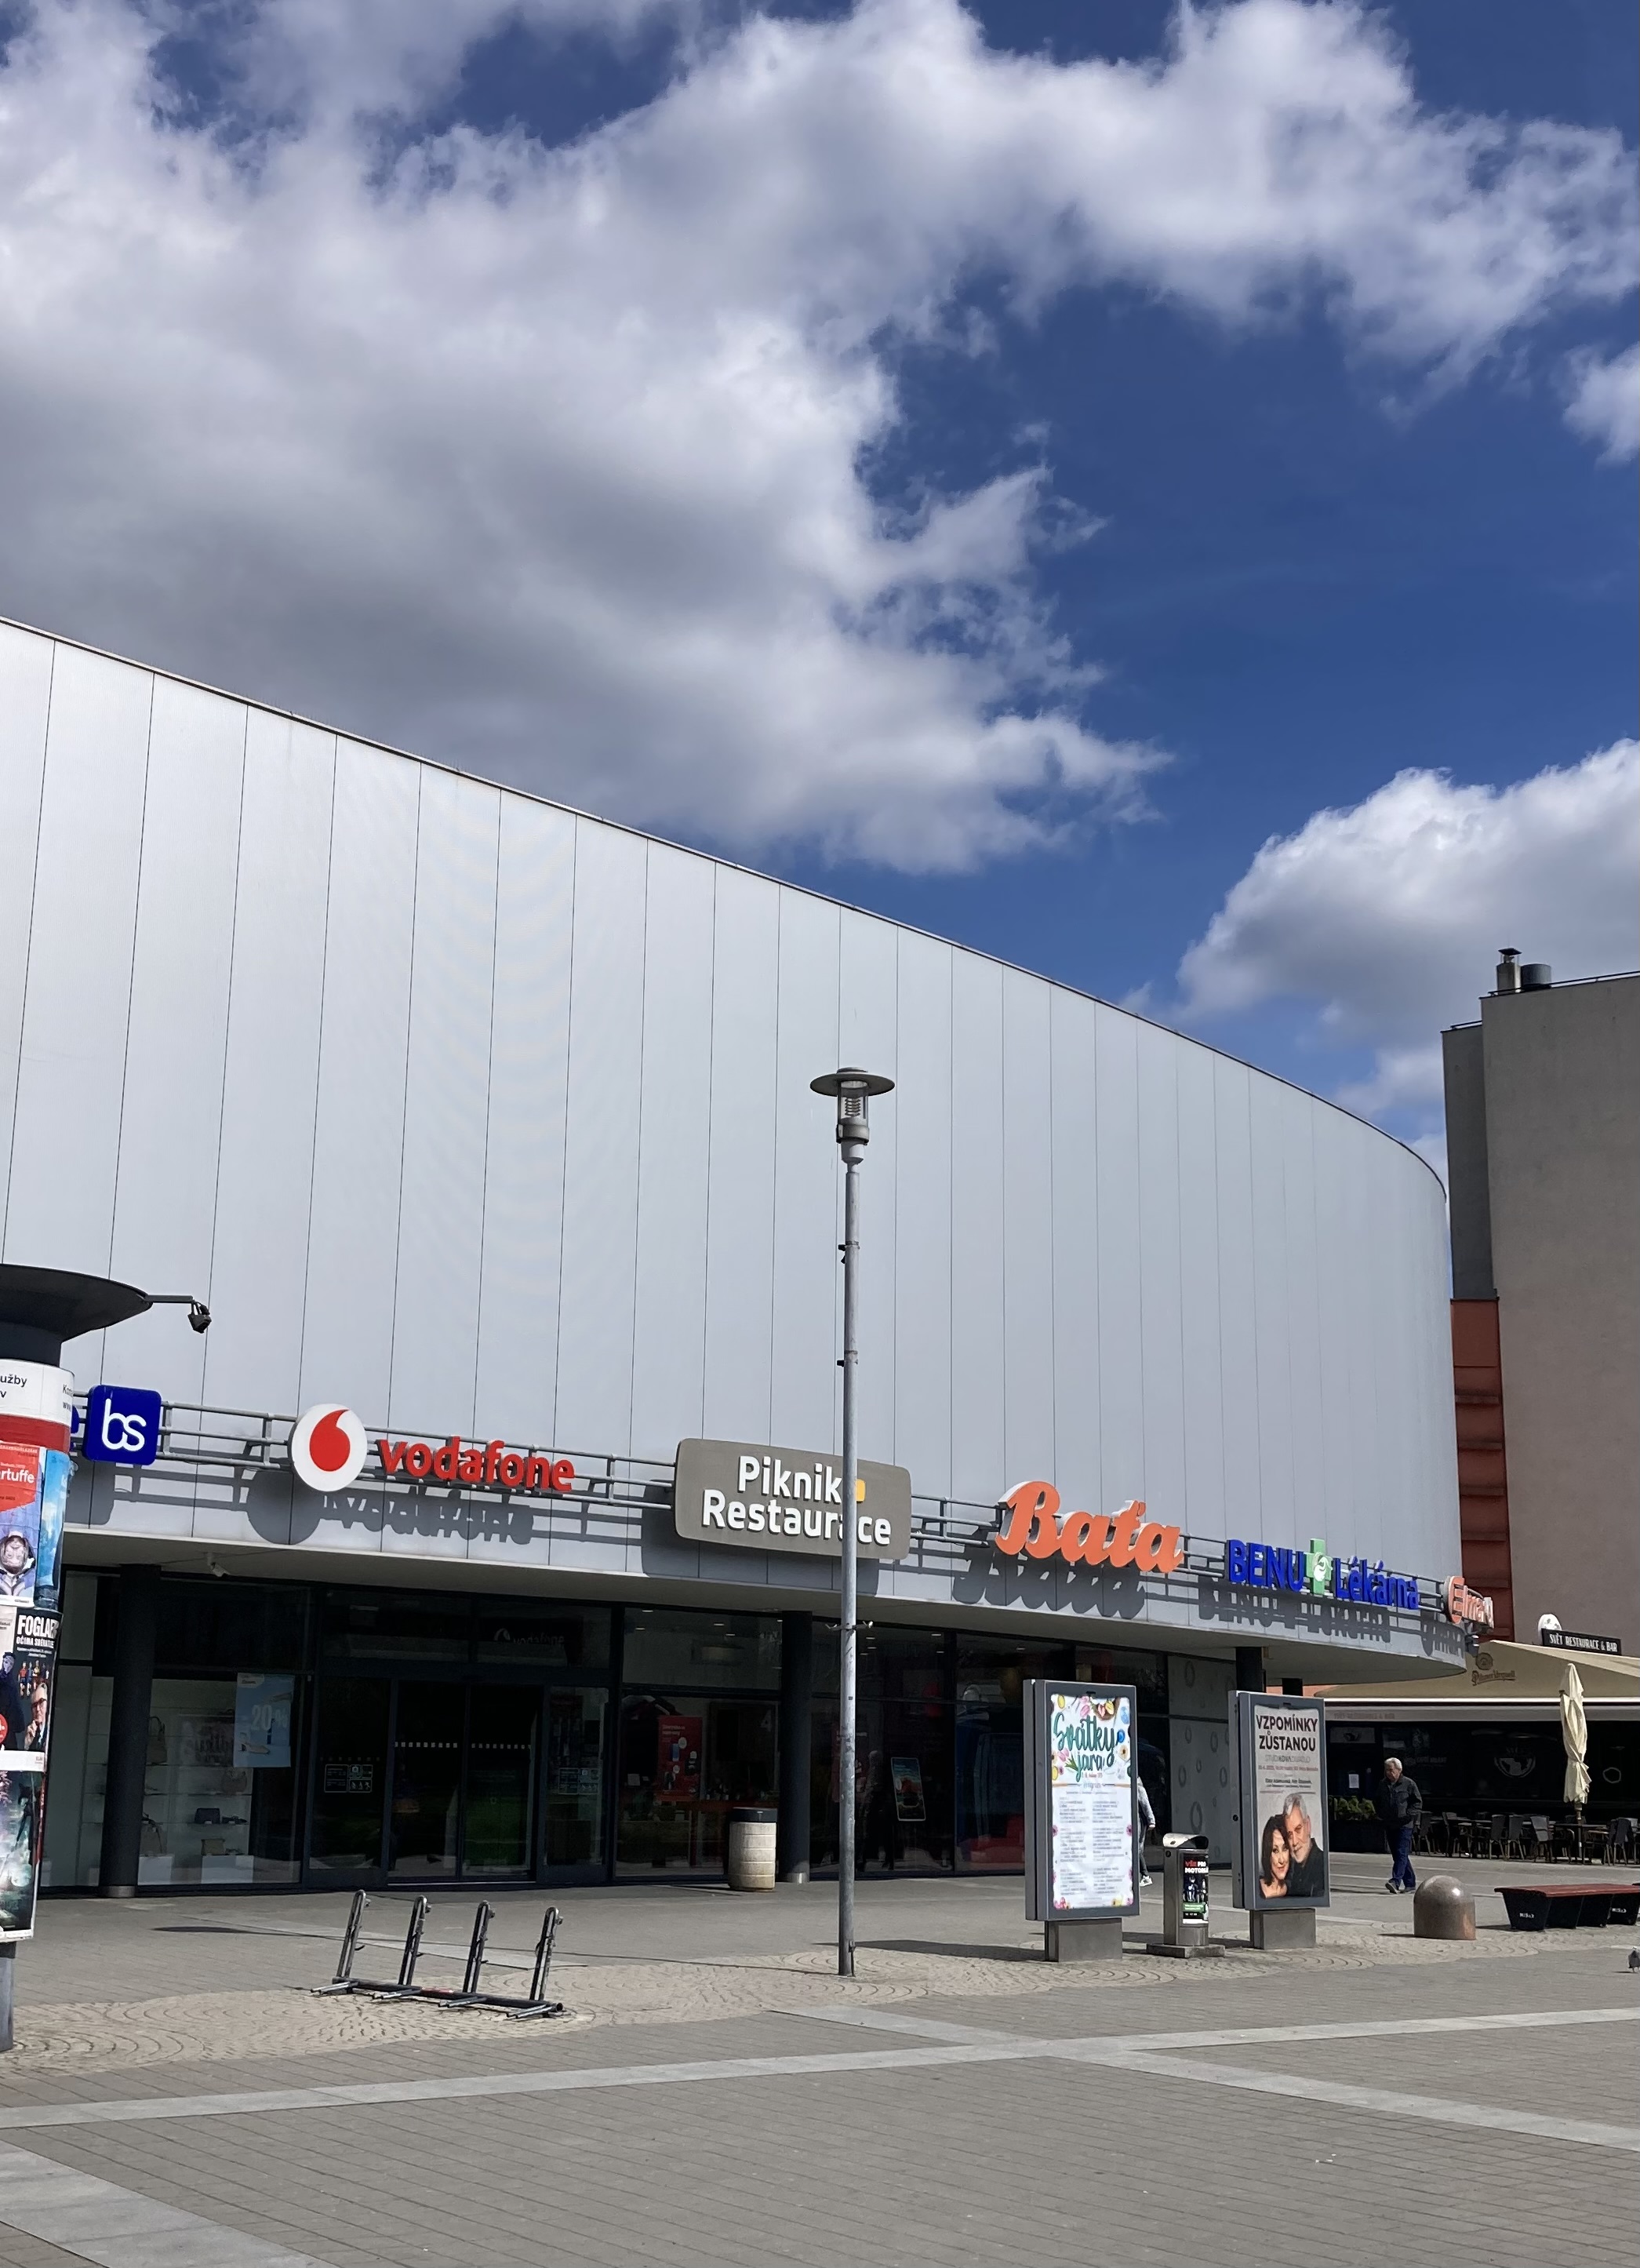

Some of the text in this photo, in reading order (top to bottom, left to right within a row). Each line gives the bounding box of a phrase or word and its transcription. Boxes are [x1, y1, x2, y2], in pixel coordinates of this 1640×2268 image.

[102, 1398, 147, 1451] bs
[0, 1468, 35, 1483] rtuffe
[376, 1436, 575, 1493] vodafone
[738, 1455, 843, 1504] Piknik
[701, 1489, 893, 1546] Restaurce
[995, 1480, 1185, 1574] Baťa
[1228, 1539, 1419, 1610] BENU Lékárna
[16, 1615, 60, 1639] FOGLAR
[1549, 1633, 1563, 1645] SVĚT
[1605, 1641, 1618, 1652] BAR
[1053, 1712, 1118, 1767] Svátky
[1256, 1713, 1318, 1732] VZPOMÍNKY
[1259, 1730, 1316, 1752] ZŮSTANOU
